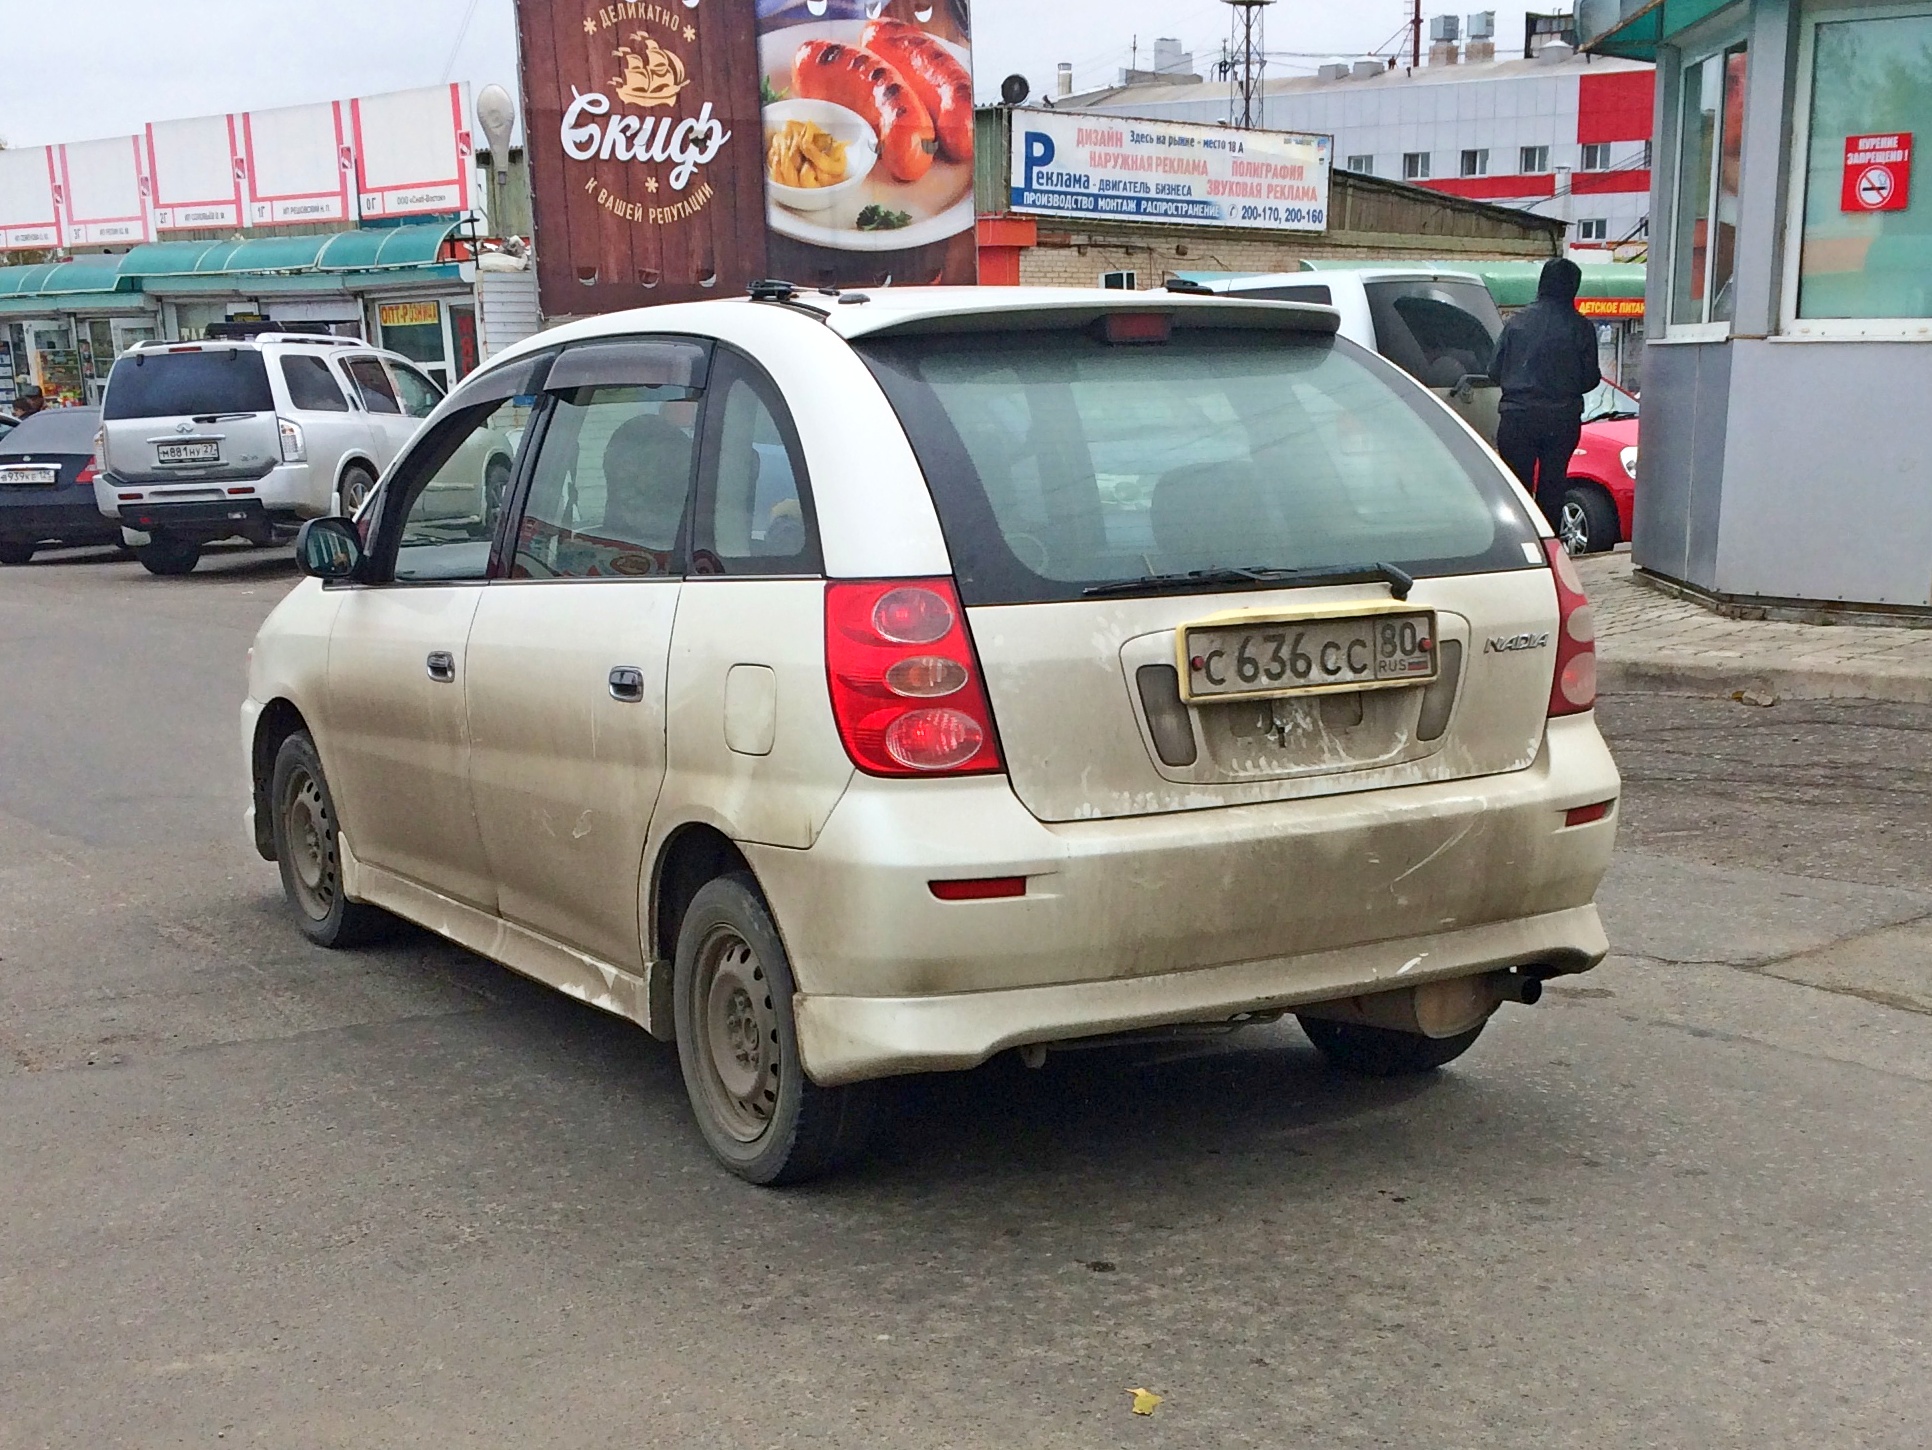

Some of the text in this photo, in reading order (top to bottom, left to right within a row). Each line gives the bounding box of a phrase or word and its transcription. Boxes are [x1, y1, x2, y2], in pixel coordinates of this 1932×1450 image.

[599, 2, 680, 32] ДЕЛИКАТНО
[561, 85, 732, 190] Скиф
[1076, 127, 1124, 148] ДИЗАЙН
[1130, 130, 1154, 144] Здесь
[1156, 134, 1166, 145] на
[1203, 138, 1226, 149] место
[1228, 141, 1236, 153] 18
[1858, 136, 1899, 150] КУРЕНИЕ
[1090, 151, 1208, 176] НАРУЖНАЯ РЕКЛАМА
[1231, 160, 1304, 181] ПОЛИГРАФИЯ
[1098, 179, 1151, 194] ДВИГАТЕЛЬ
[1155, 183, 1193, 196] БИЗНЕСА
[1207, 179, 1318, 202] ЗВУКОВАЯ РЕКЛАМА
[585, 177, 714, 224] К ВАШЕЙ РЕПУТАЦИИ
[1023, 192, 1221, 217] ПРОИЗВОДСТВО МОНТАЖ РАСПРОСТРАНЕНИЕ
[1241, 205, 1324, 224] 200-170, 200-160
[1579, 301, 1617, 313] ДЕТСКОЕ
[1379, 621, 1417, 658] 80
[1483, 631, 1550, 654] NADIA
[1378, 658, 1407, 674] RUS
